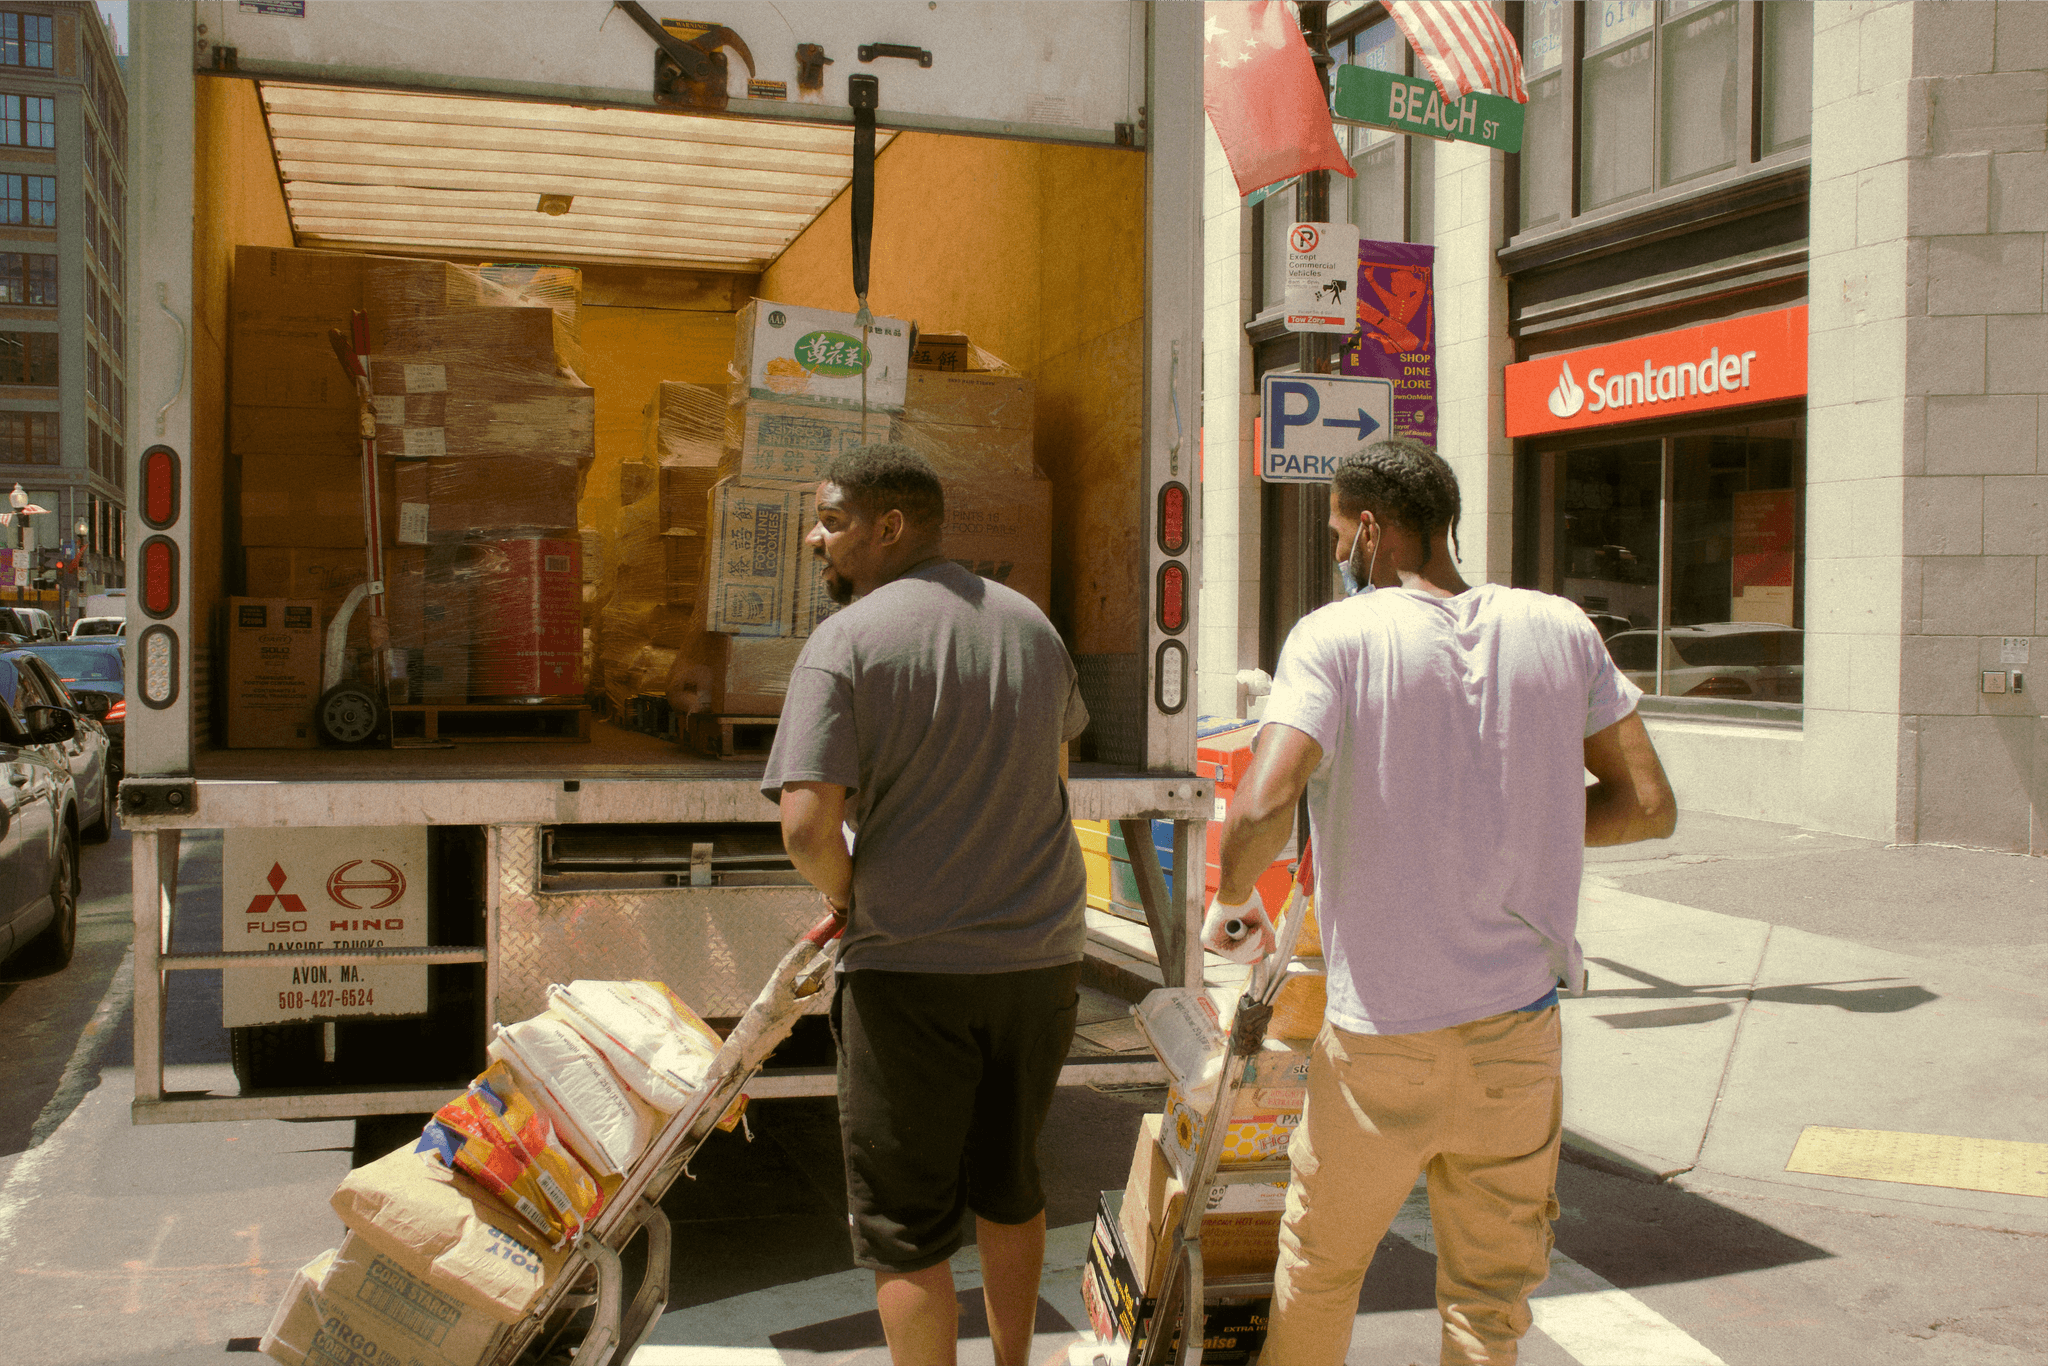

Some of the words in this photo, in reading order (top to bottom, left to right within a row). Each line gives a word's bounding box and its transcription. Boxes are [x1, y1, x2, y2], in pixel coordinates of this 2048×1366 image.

[1389, 81, 1477, 135] BEACH
[1482, 119, 1500, 140] ST
[1289, 253, 1316, 261] Except
[1400, 353, 1430, 363] SHOP
[1404, 366, 1431, 376] DINE
[1588, 346, 1756, 411] Santander
[1393, 379, 1432, 389] PLORE
[1271, 381, 1320, 449] P
[1271, 454, 1343, 475] PARK
[952, 523, 984, 533] FOOD
[986, 524, 1017, 534] PAILS
[754, 510, 769, 571] FORTUNE
[765, 512, 779, 570] COOKIES
[247, 920, 308, 933] FUSO
[330, 919, 404, 931] HINO
[341, 965, 365, 982] MA.
[279, 988, 374, 1009] 508-427-6524
[1236, 1217, 1254, 1226] HOT
[487, 1225, 544, 1264] LINER
[485, 1241, 540, 1275] POLY
[368, 1262, 409, 1293] CORN
[405, 1284, 461, 1324] STARCH
[324, 1316, 377, 1358] ARGO
[1223, 1325, 1255, 1333] EXTRA
